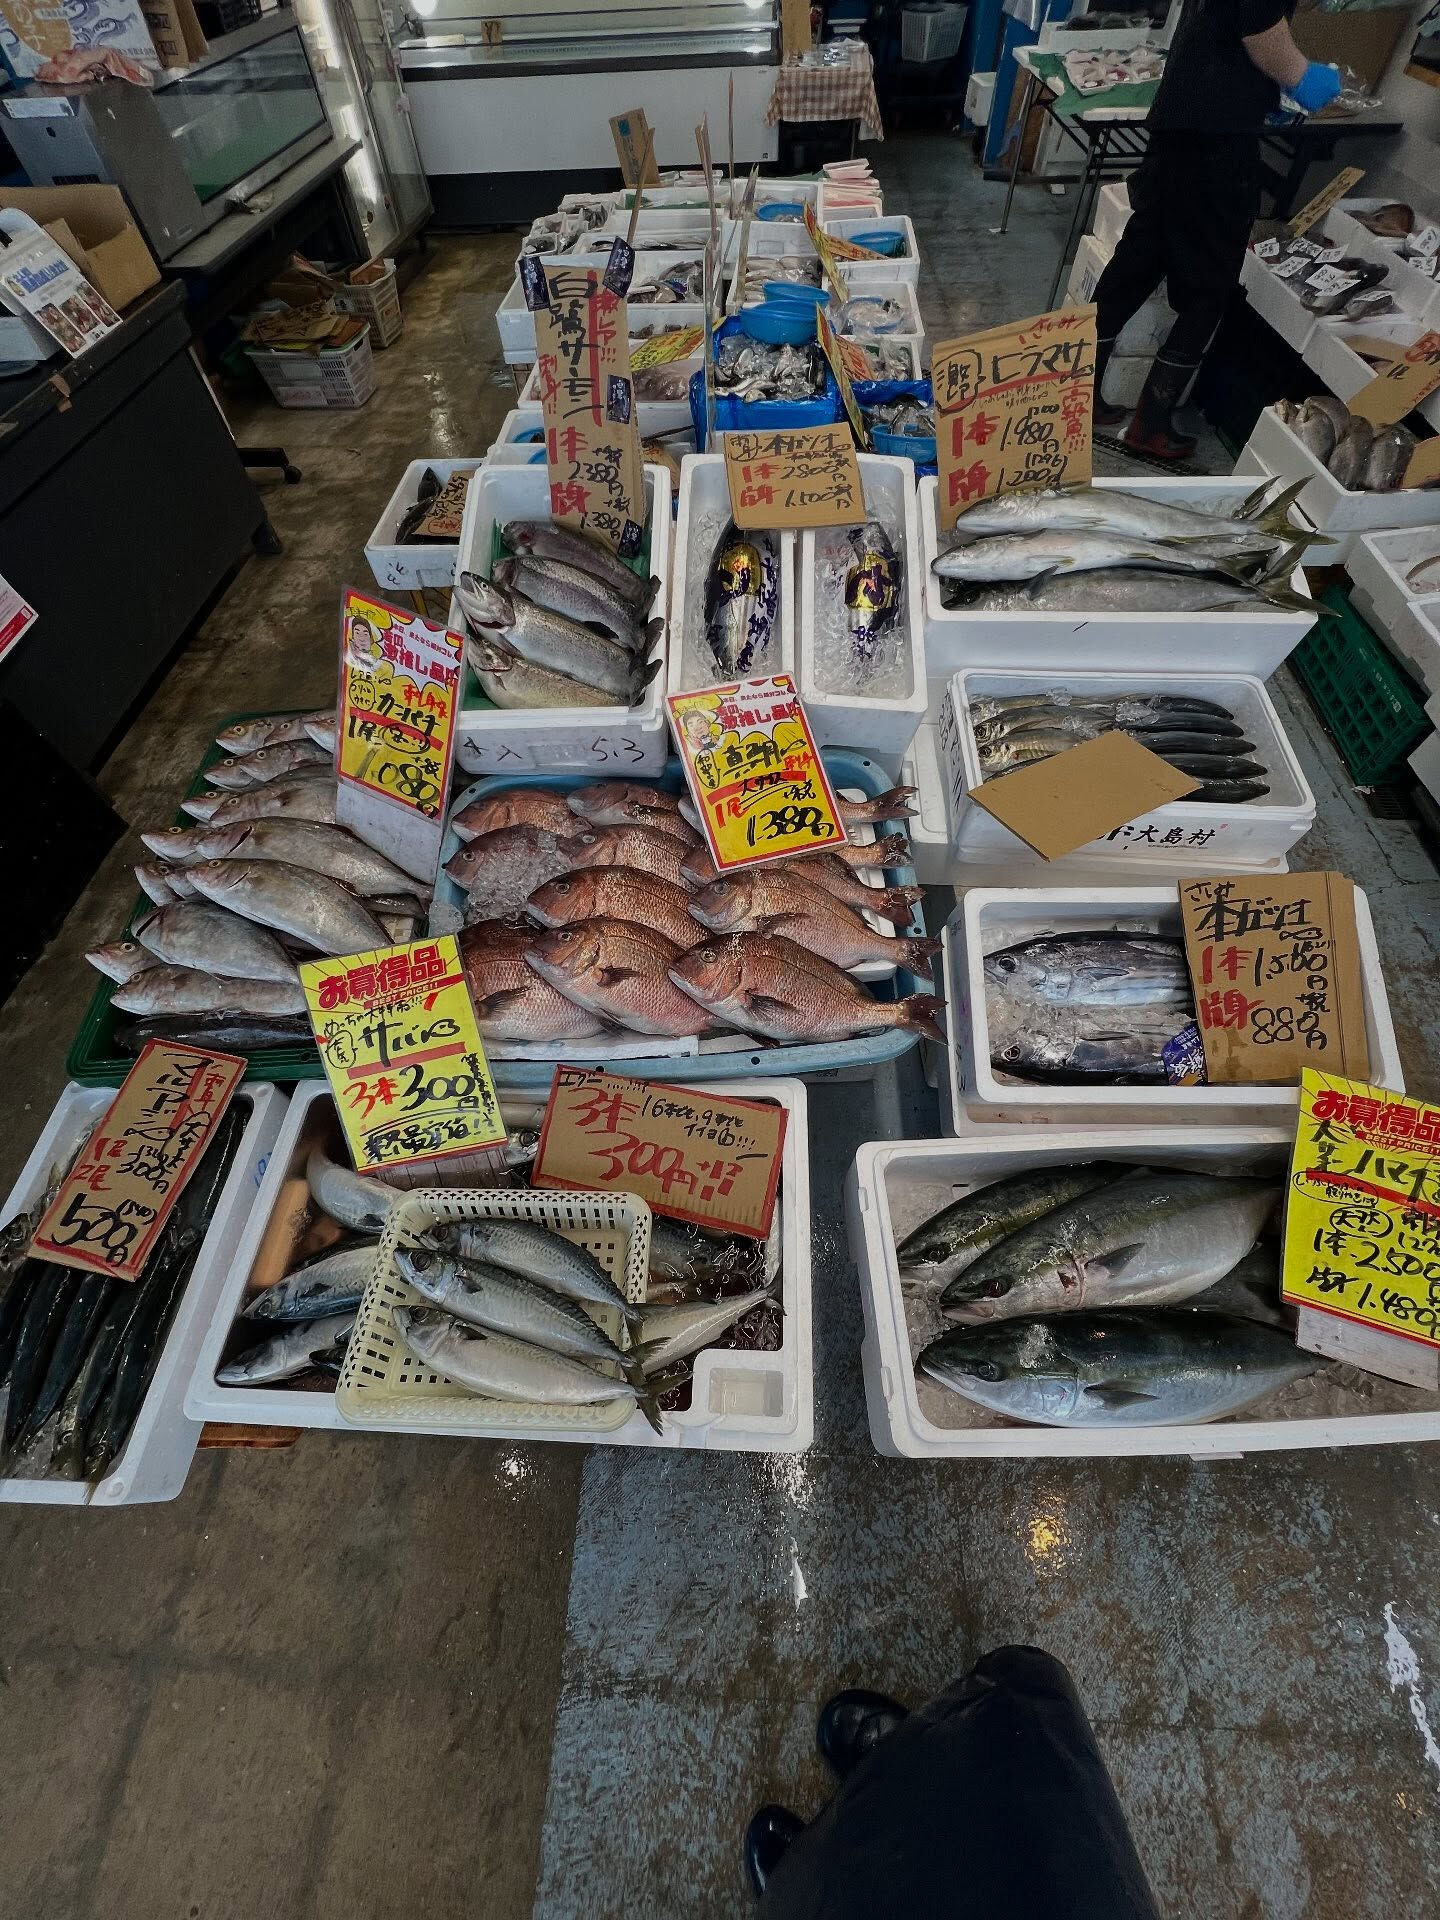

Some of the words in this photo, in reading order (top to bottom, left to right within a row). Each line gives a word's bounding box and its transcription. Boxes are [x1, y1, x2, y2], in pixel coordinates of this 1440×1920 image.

[993, 338, 1092, 384] ヒラマサ
[317, 945, 448, 1010] お買得品
[1203, 946, 1253, 985] 1本
[372, 992, 398, 1008] BEST
[343, 1076, 399, 1119] 3本
[567, 1087, 640, 1133] 3本
[1365, 1133, 1396, 1148] BEST
[1314, 1228, 1347, 1256] 1本
